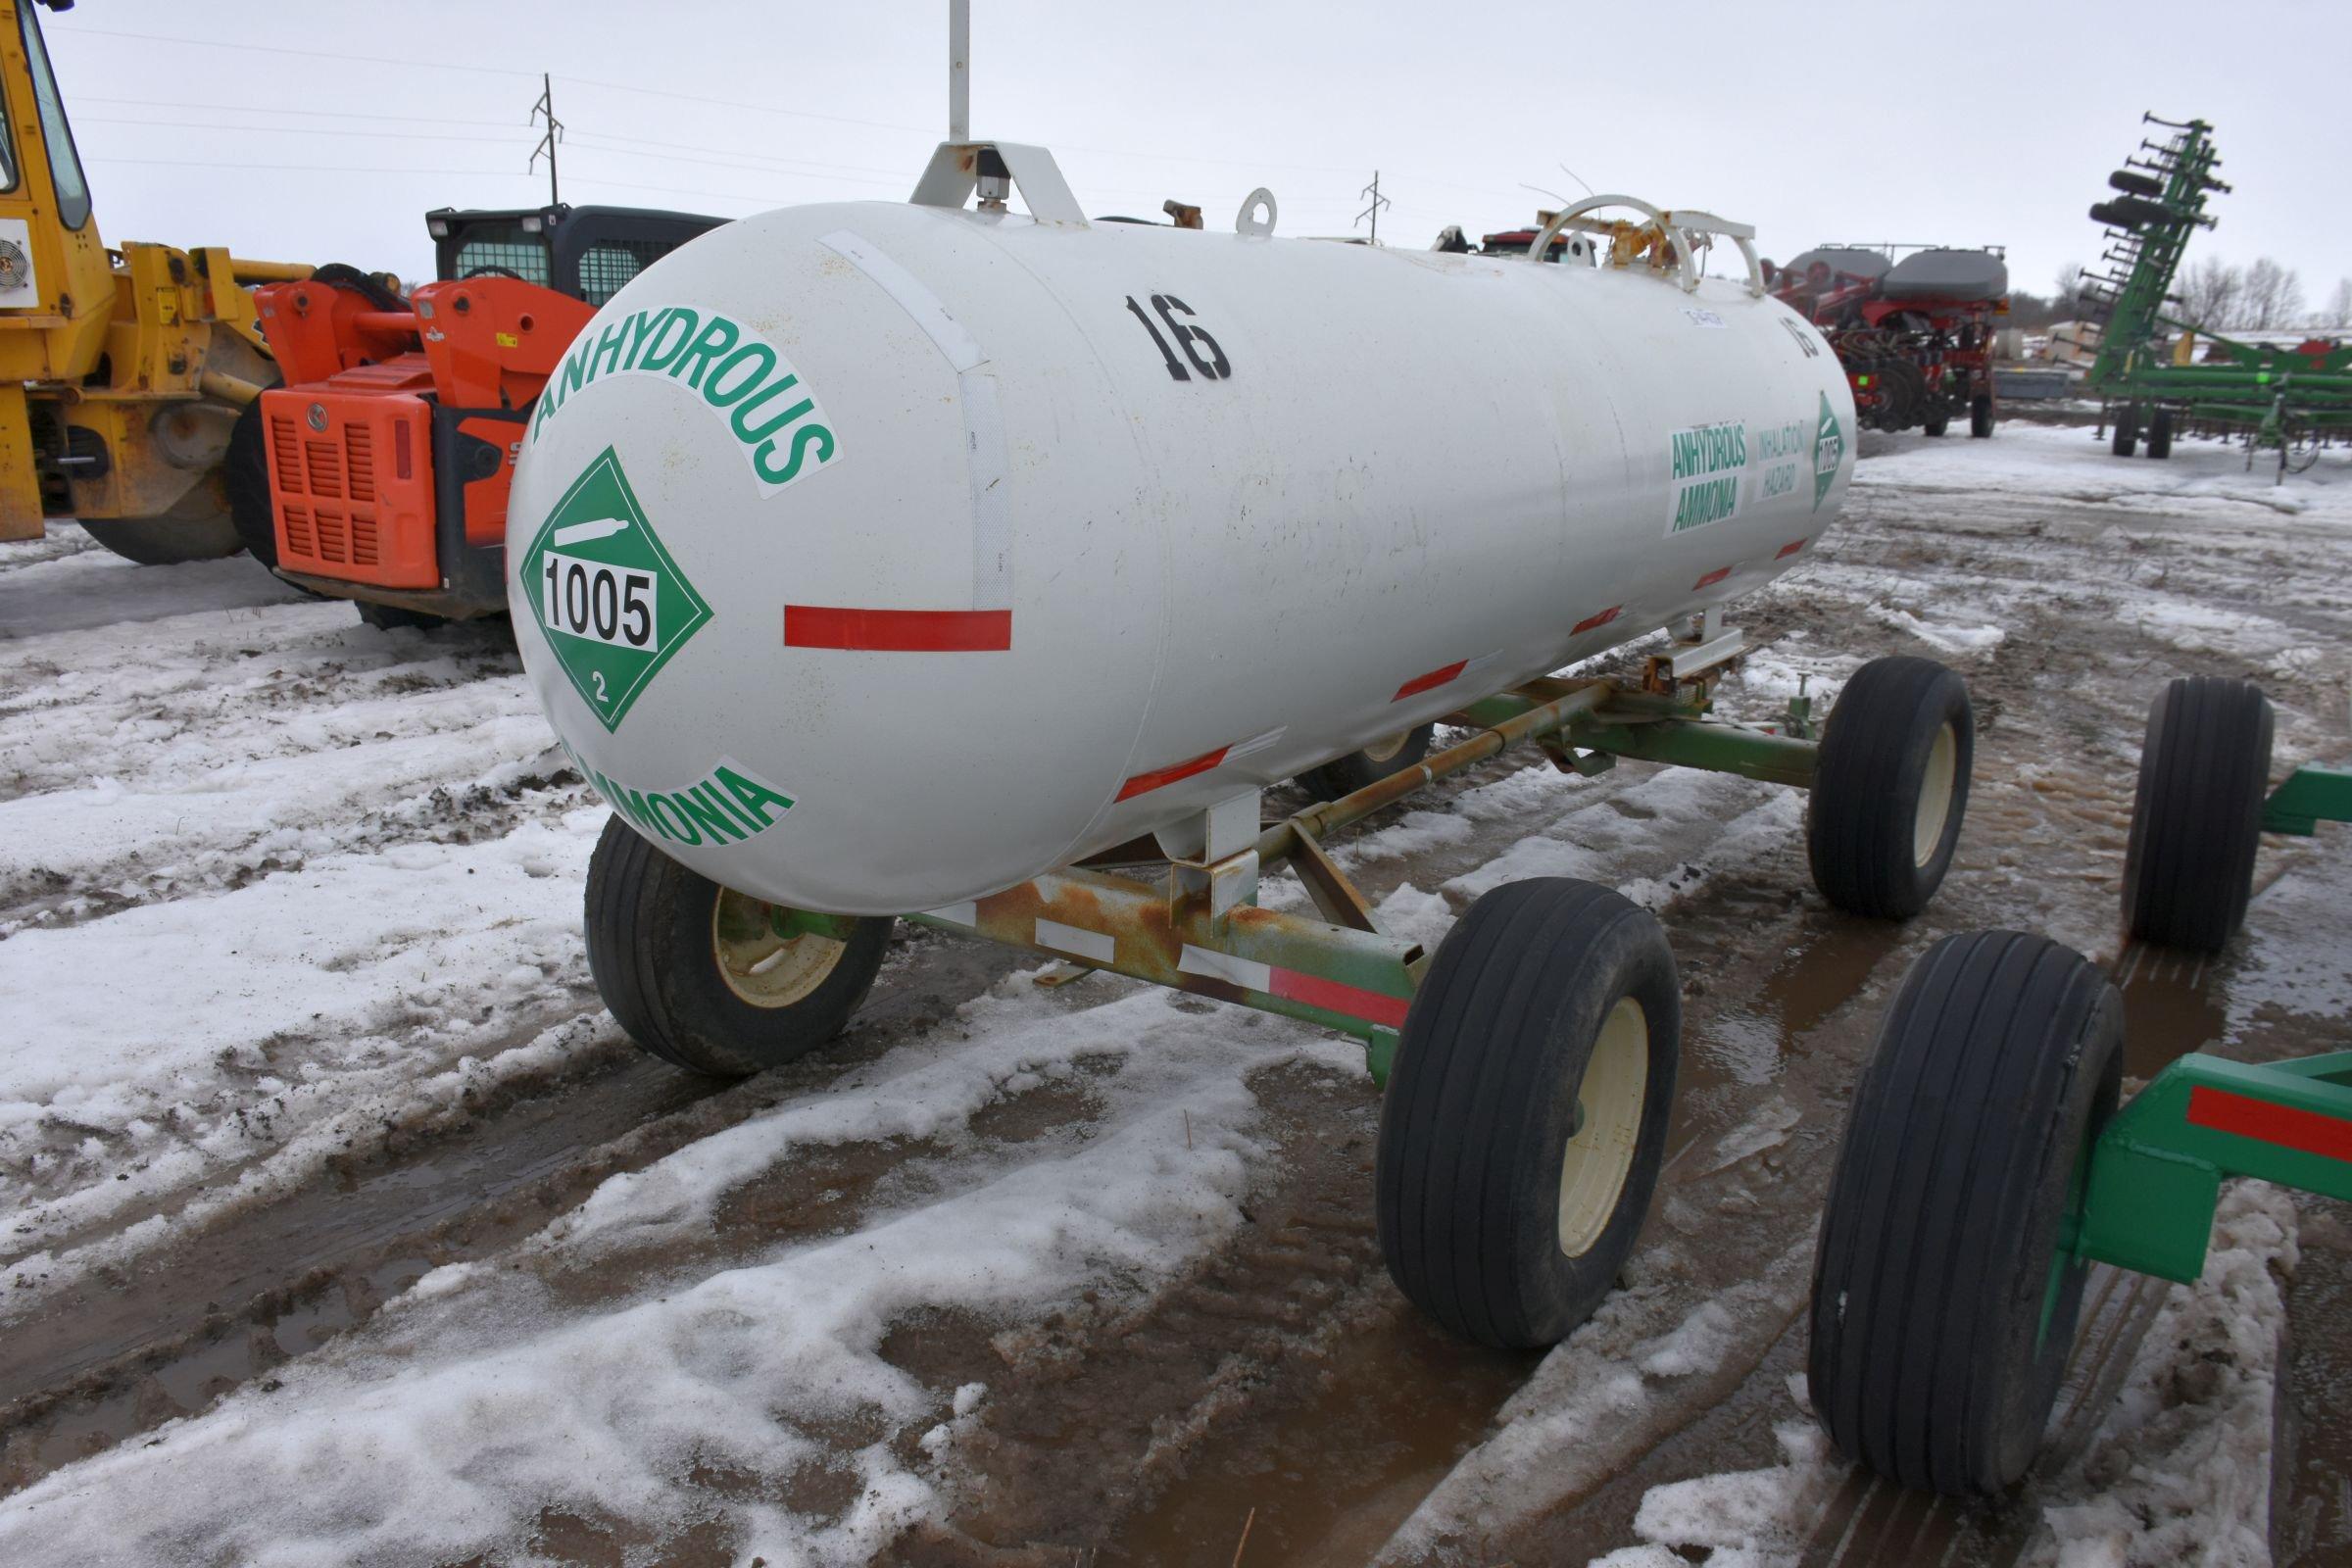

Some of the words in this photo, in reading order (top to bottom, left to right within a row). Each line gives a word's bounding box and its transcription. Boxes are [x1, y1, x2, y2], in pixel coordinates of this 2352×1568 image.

[1125, 294, 1232, 381] 16
[532, 307, 835, 485] ANHYDROUS
[1672, 423, 1746, 480] ANHYDROUS
[1672, 476, 1738, 532] AMMONIA
[546, 558, 652, 647] 1005
[592, 670, 610, 703] 2
